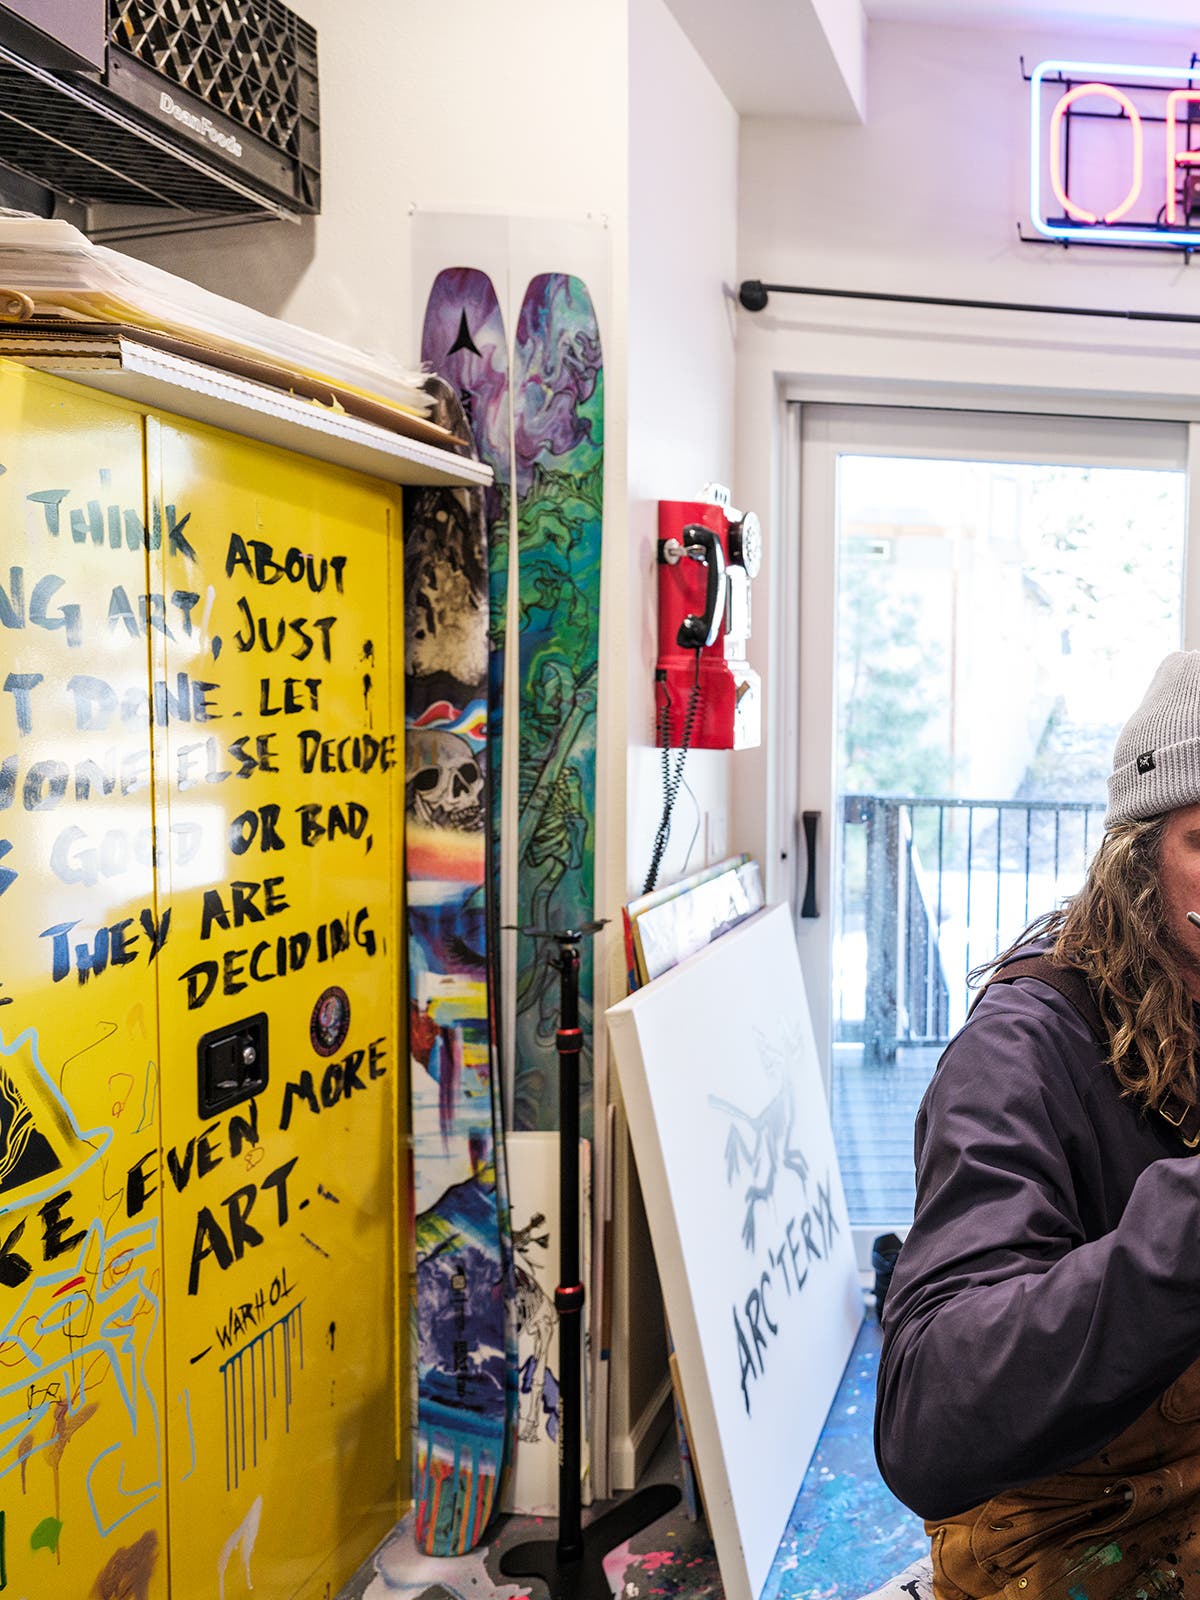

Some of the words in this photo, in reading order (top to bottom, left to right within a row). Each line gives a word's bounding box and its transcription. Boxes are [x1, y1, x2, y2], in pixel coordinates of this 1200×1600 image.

[225, 533, 347, 594] ABOUT
[233, 596, 338, 663] JUST
[259, 677, 322, 717] LET
[177, 732, 281, 792] ELSE
[297, 729, 398, 774] DECIDE
[227, 803, 286, 855] OR
[295, 801, 373, 855] BAD,
[39, 906, 172, 986] THEY
[199, 876, 290, 941] ARE
[126, 1098, 260, 1217] EVEN
[280, 1036, 387, 1130] MORE
[732, 1167, 840, 1417] ARC'TERYX
